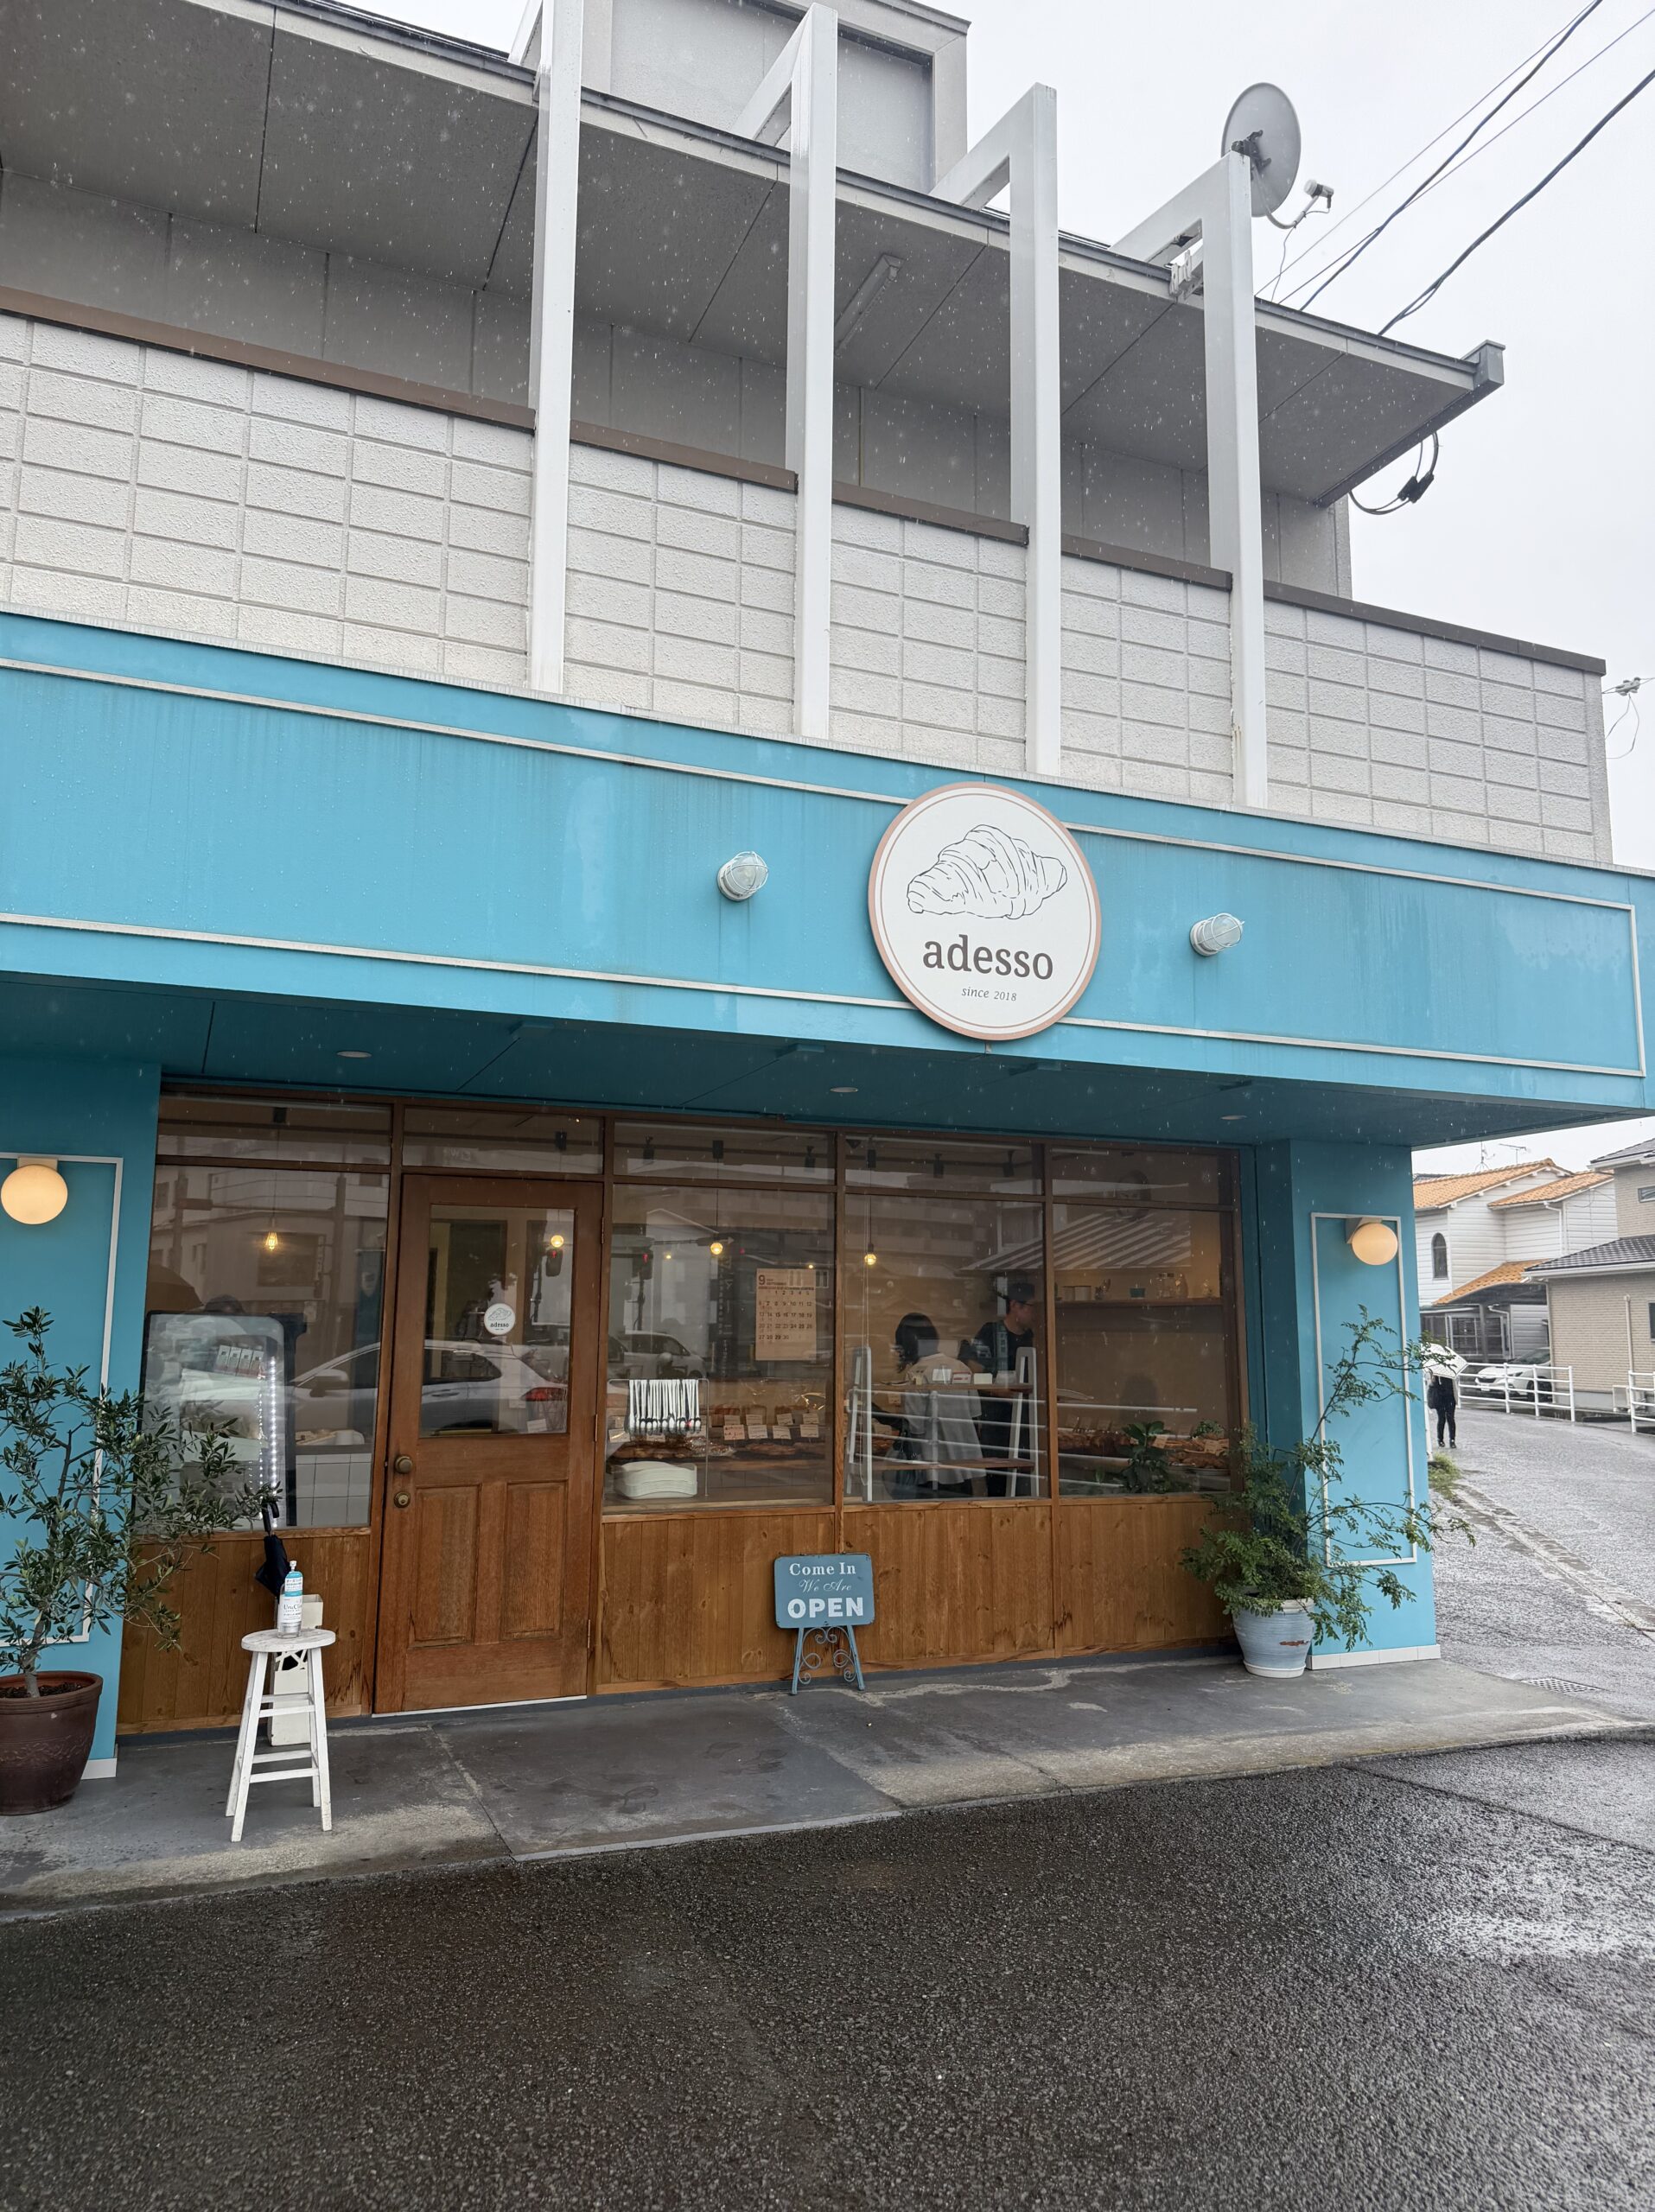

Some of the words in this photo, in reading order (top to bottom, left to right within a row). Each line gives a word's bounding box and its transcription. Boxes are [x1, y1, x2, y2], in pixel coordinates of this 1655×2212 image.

[922, 934, 1053, 980] adesso
[961, 987, 990, 998] since
[994, 990, 1017, 1001] 2018
[758, 1274, 766, 1286] 9
[789, 1562, 835, 1576] Come
[839, 1562, 856, 1574] In
[799, 1579, 820, 1593] We
[823, 1579, 852, 1592] Are
[787, 1597, 864, 1618] OPEN
